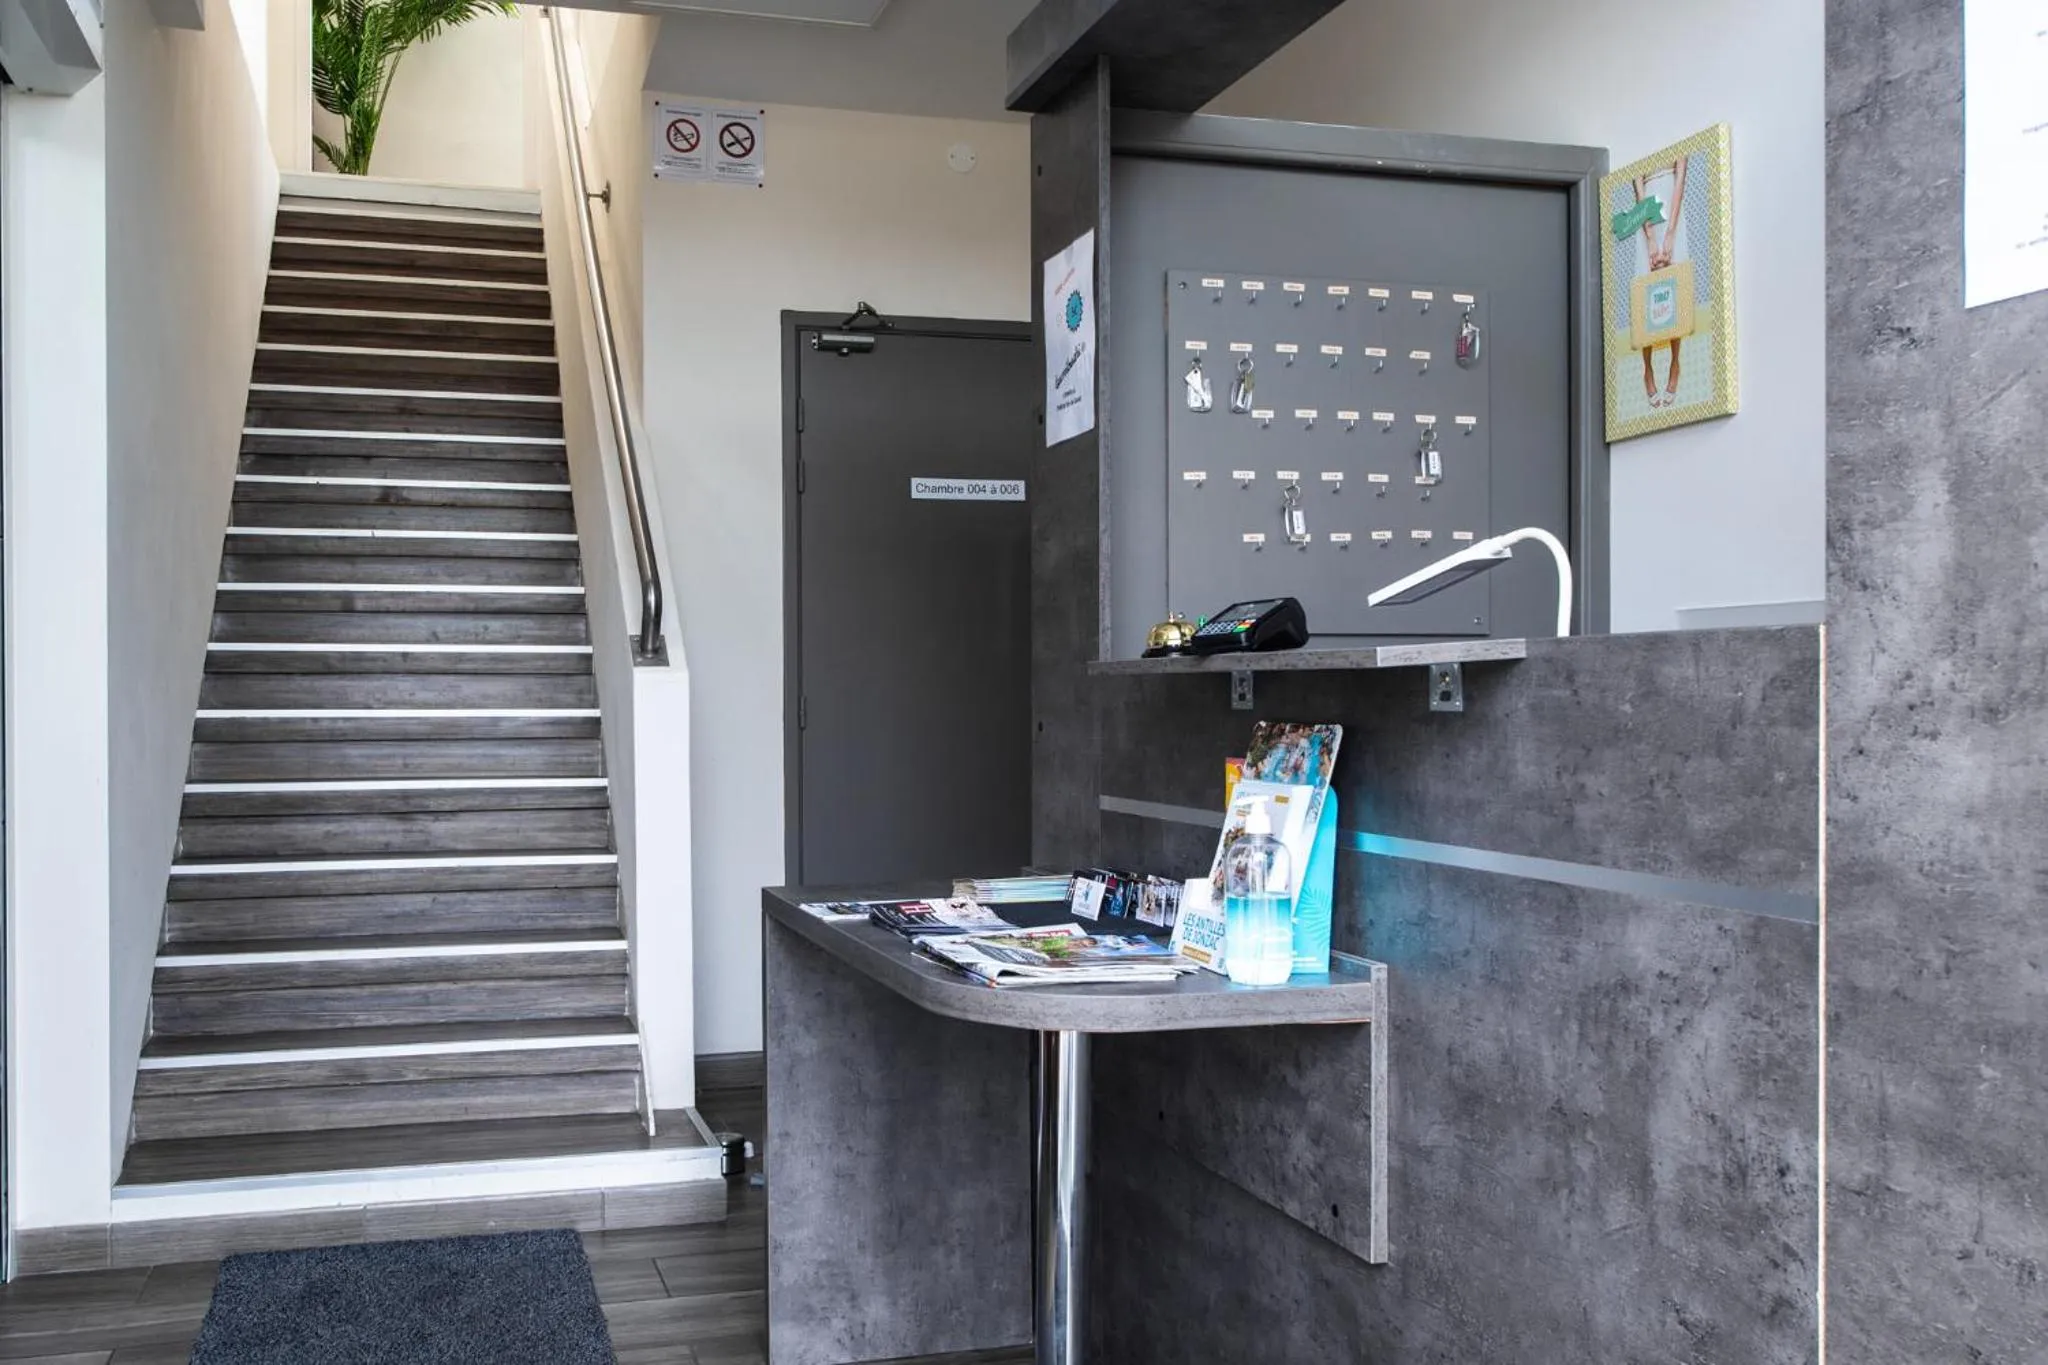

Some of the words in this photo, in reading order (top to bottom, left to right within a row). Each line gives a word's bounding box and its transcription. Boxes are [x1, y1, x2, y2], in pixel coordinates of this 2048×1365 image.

[915, 482, 964, 494] Chambre
[968, 484, 987, 495] 004
[990, 484, 998, 495] à
[1183, 912, 1197, 927] LES
[1195, 916, 1226, 937] ANTILLES
[1183, 927, 1193, 942] DE
